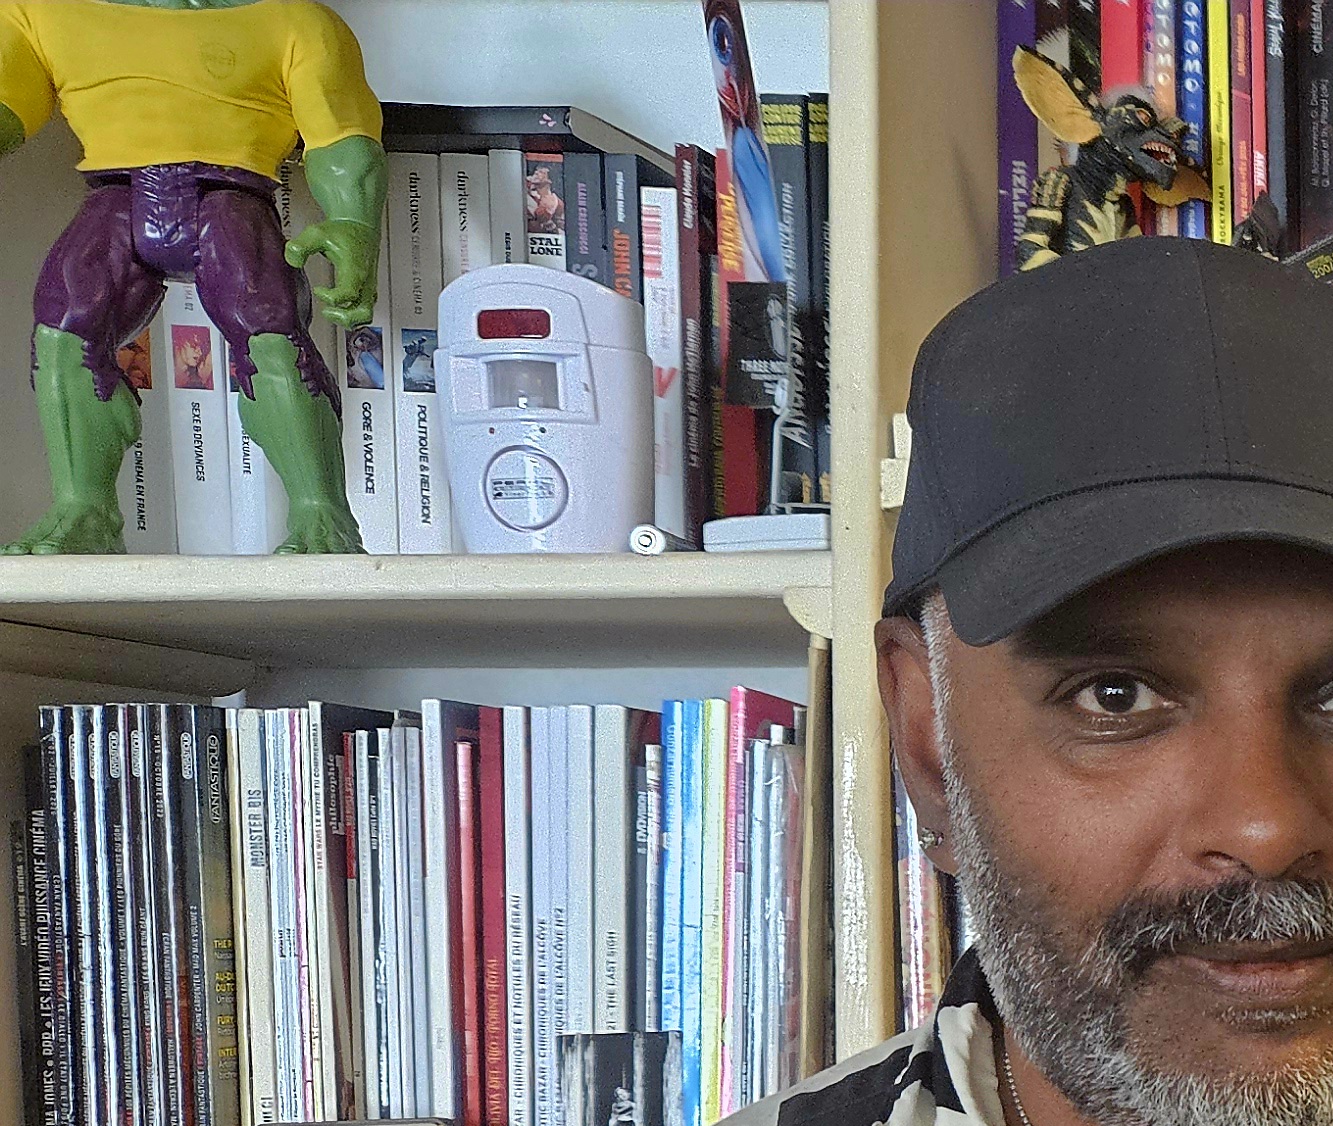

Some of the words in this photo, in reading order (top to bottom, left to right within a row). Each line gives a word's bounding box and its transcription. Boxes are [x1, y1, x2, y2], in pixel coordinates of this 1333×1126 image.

[530, 237, 562, 247] STAL
[530, 246, 562, 256] LONE
[361, 401, 373, 431] GORE
[418, 404, 429, 462] POLITIQUE
[364, 442, 376, 494] VIOLENCE
[136, 496, 147, 530] FRANCE
[420, 473, 431, 524] RELIGION
[208, 735, 221, 822] FANTASTIQUE
[250, 813, 264, 867] MONSTER
